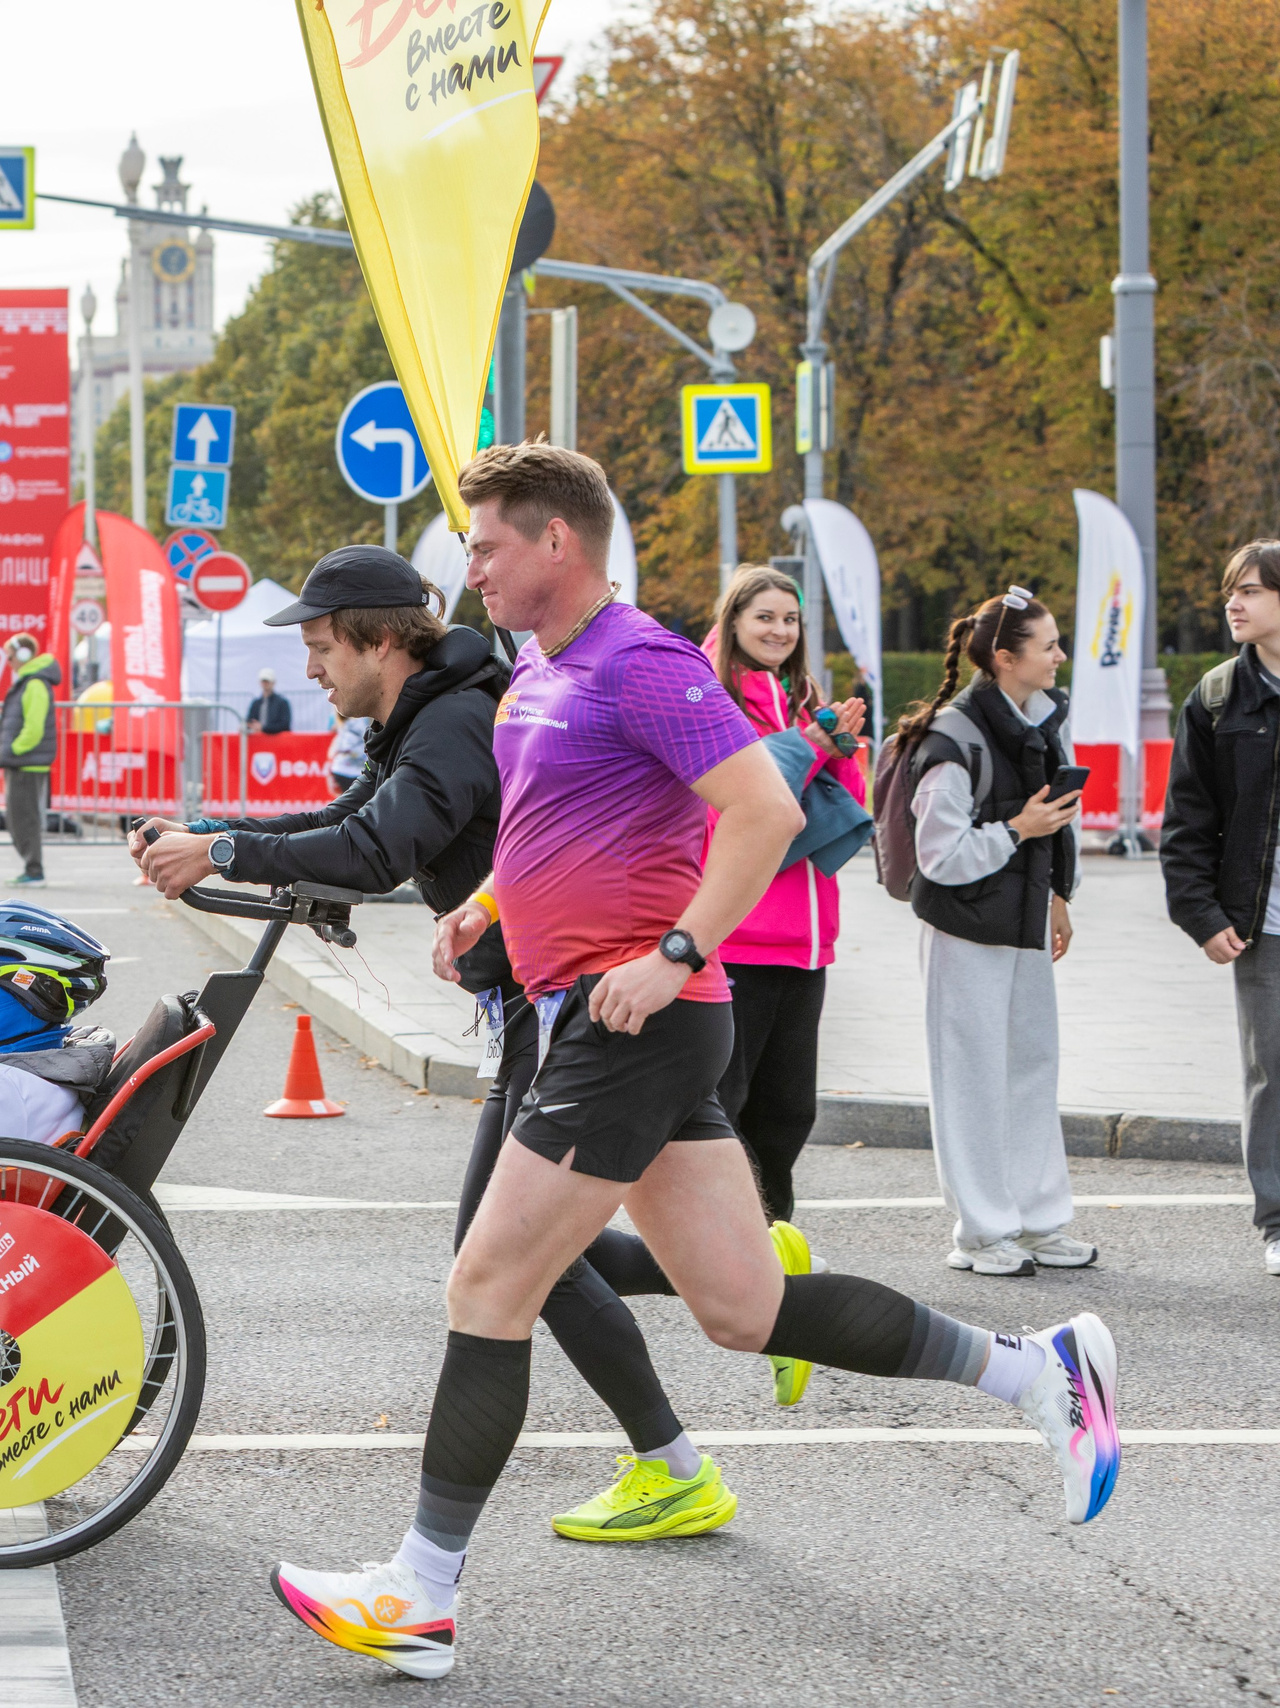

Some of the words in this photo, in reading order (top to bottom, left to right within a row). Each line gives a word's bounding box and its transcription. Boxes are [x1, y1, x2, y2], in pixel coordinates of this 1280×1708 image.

[428, 40, 522, 106] нами
[76, 609, 99, 623] 40
[20, 925, 51, 935] ALPINA
[69, 1369, 123, 1420] нами
